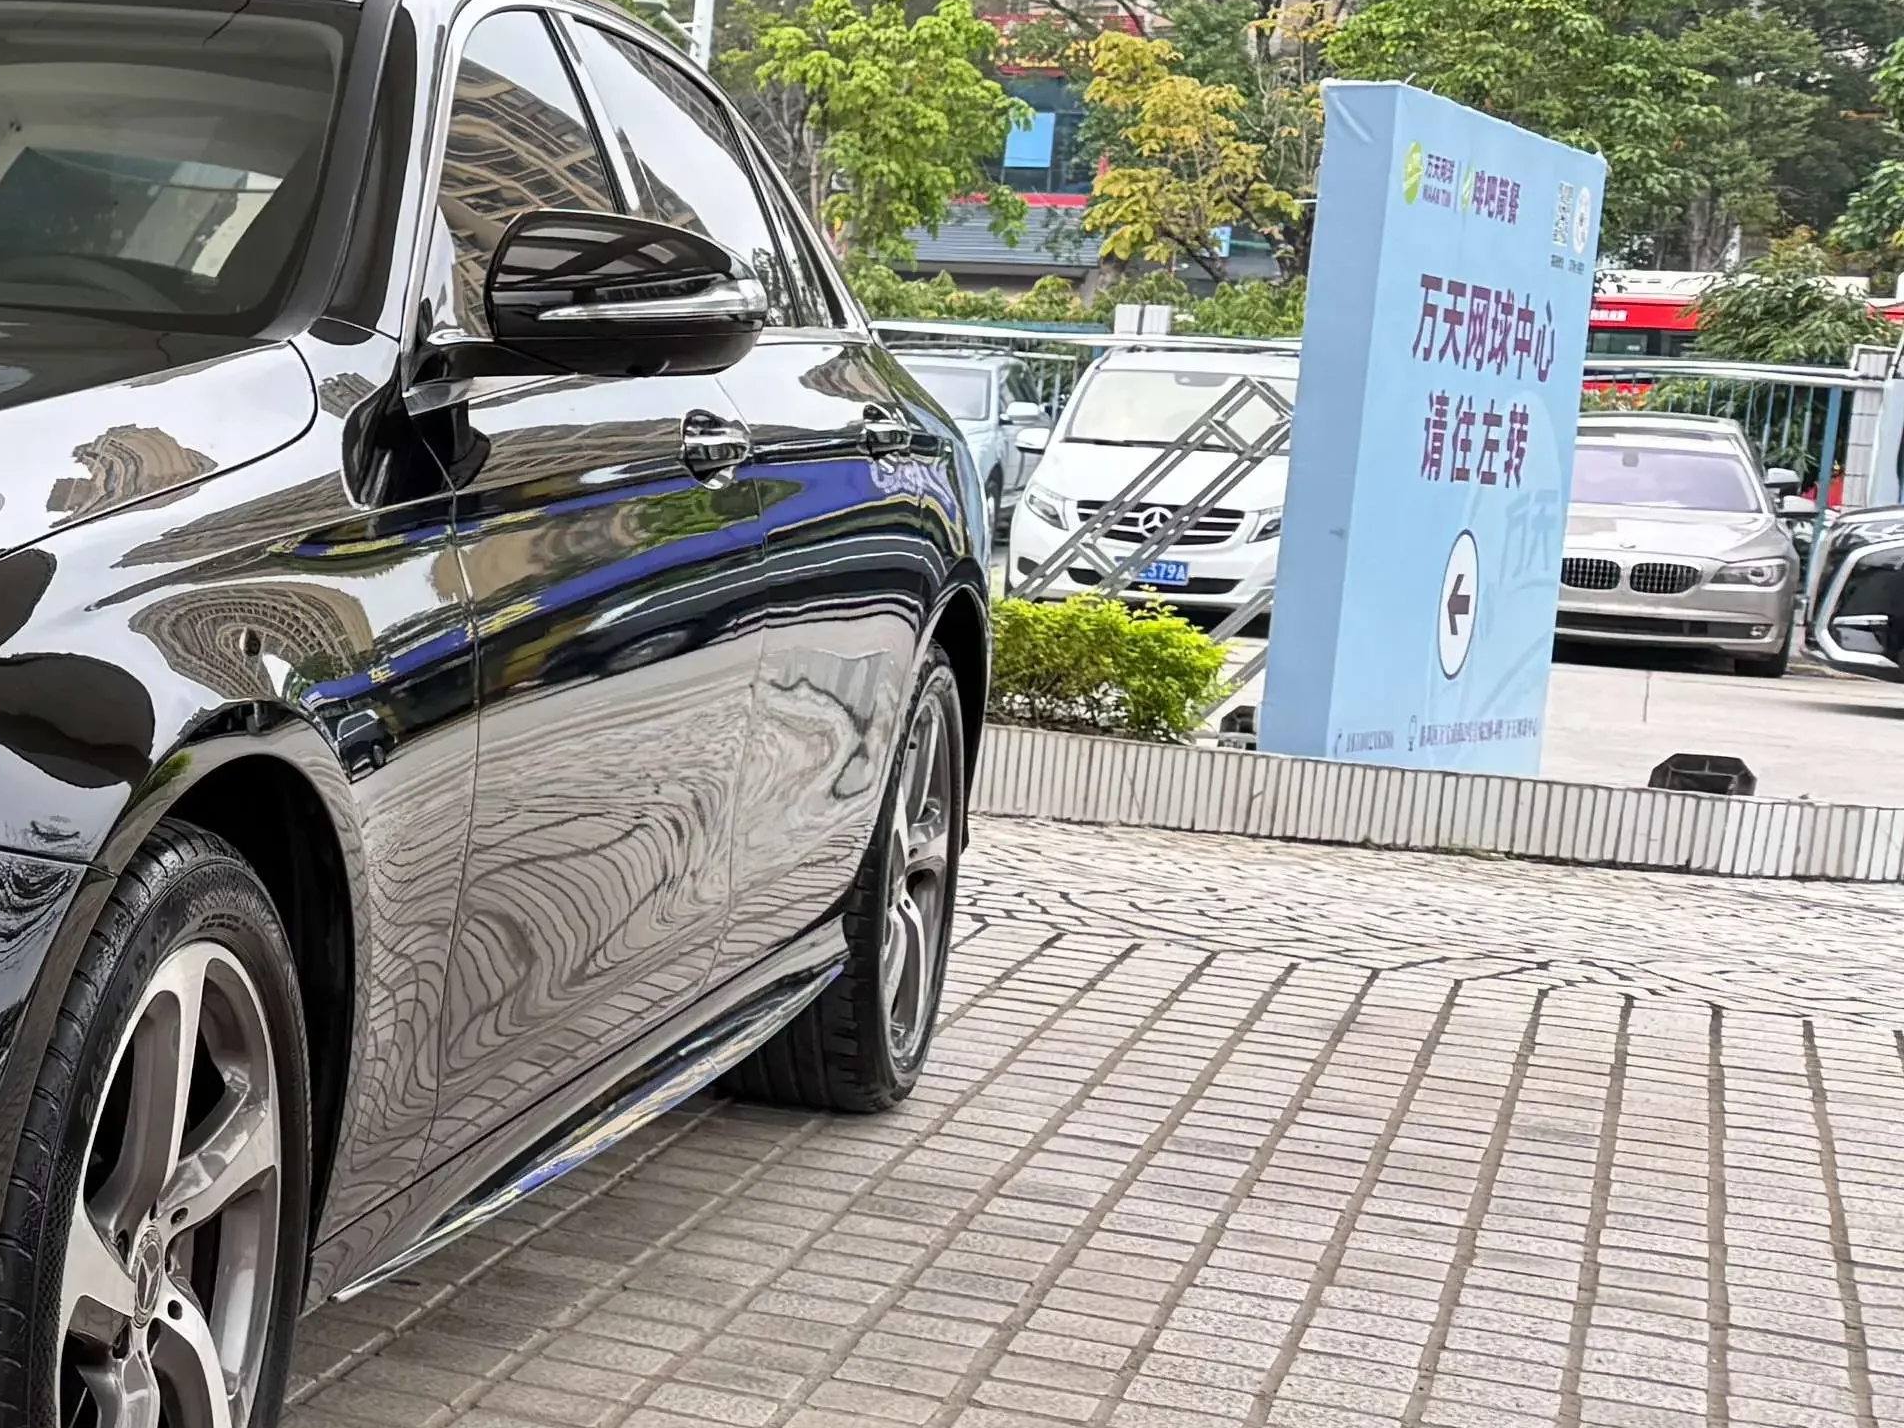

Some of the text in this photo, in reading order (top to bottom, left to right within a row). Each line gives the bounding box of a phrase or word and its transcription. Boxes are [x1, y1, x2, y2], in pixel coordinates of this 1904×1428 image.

[1412, 273, 1555, 382] 万天网球中心
[1420, 389, 1529, 489] 请往左转
[1138, 561, 1187, 580] 379A
